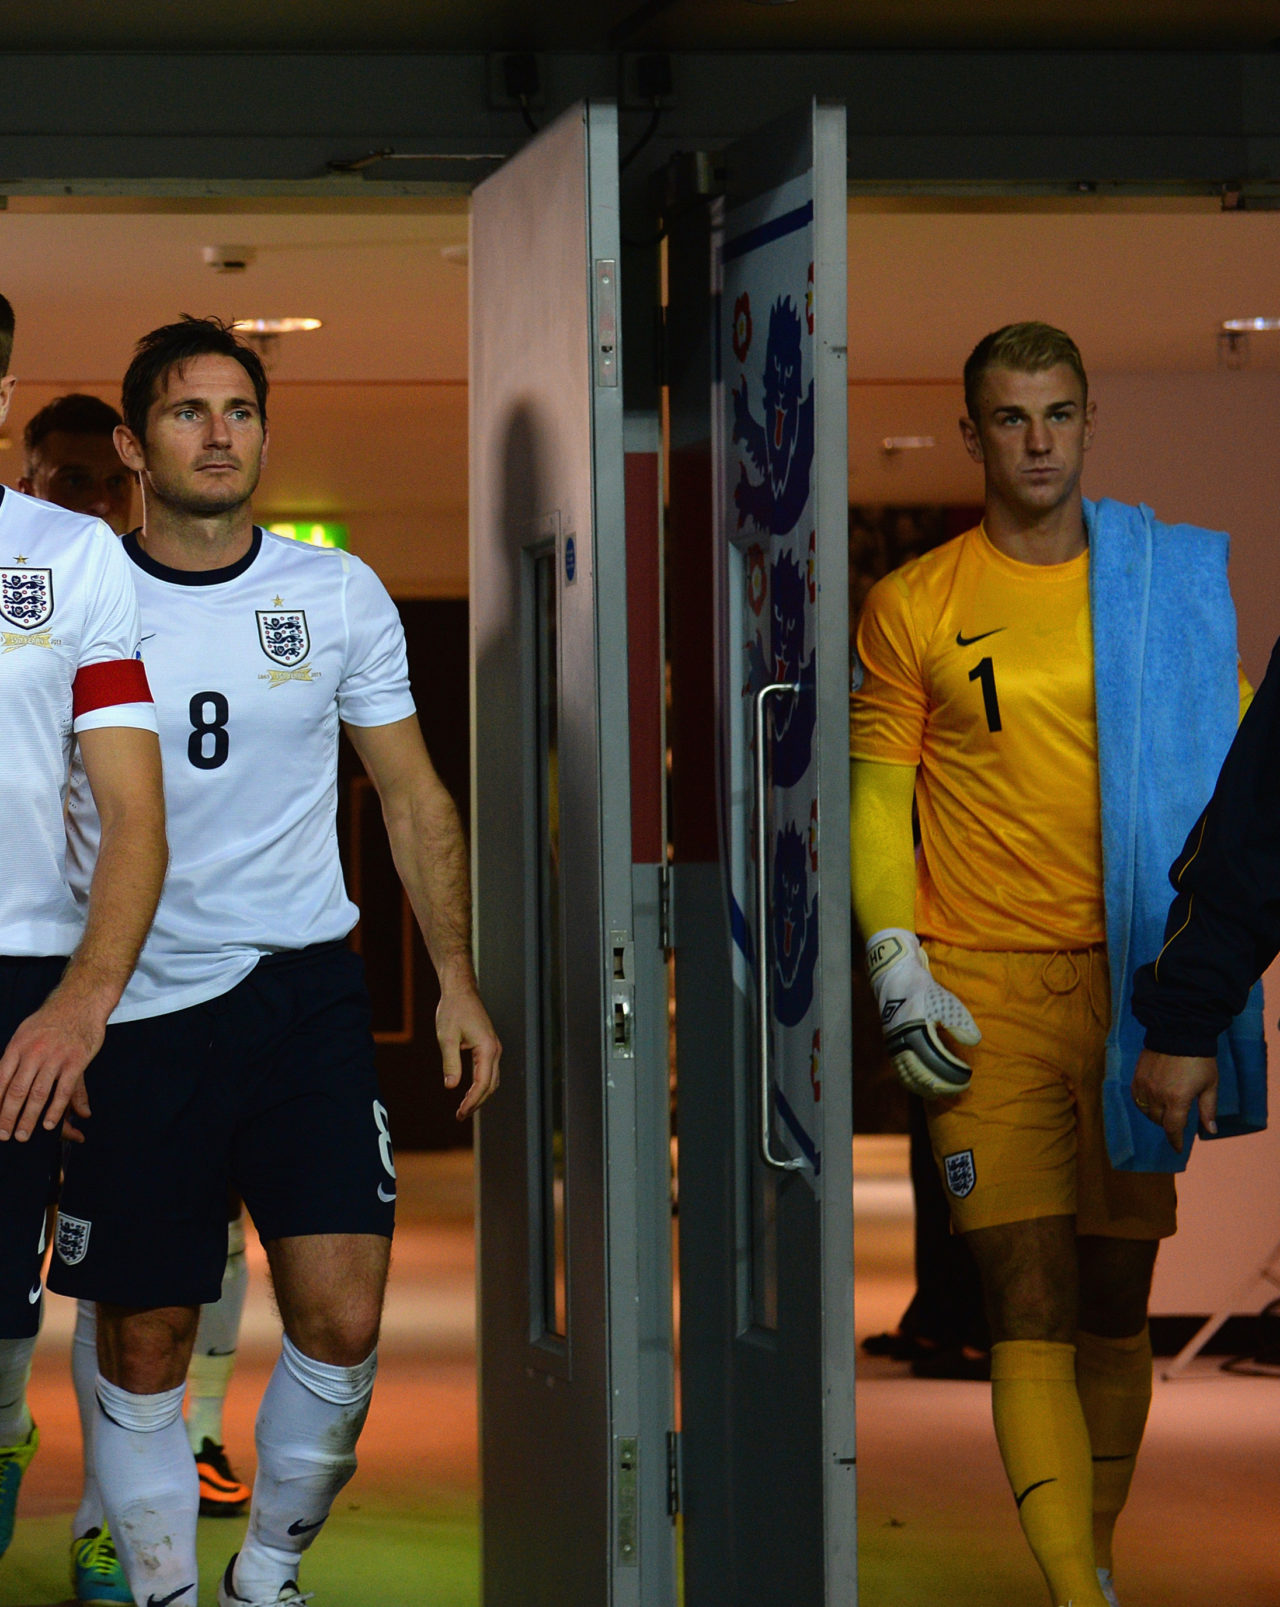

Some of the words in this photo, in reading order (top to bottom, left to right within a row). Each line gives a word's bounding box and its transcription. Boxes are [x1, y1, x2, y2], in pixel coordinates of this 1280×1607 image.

[187, 690, 229, 770] 8
[968, 656, 1002, 733] 1
[372, 1099, 397, 1179] 8
